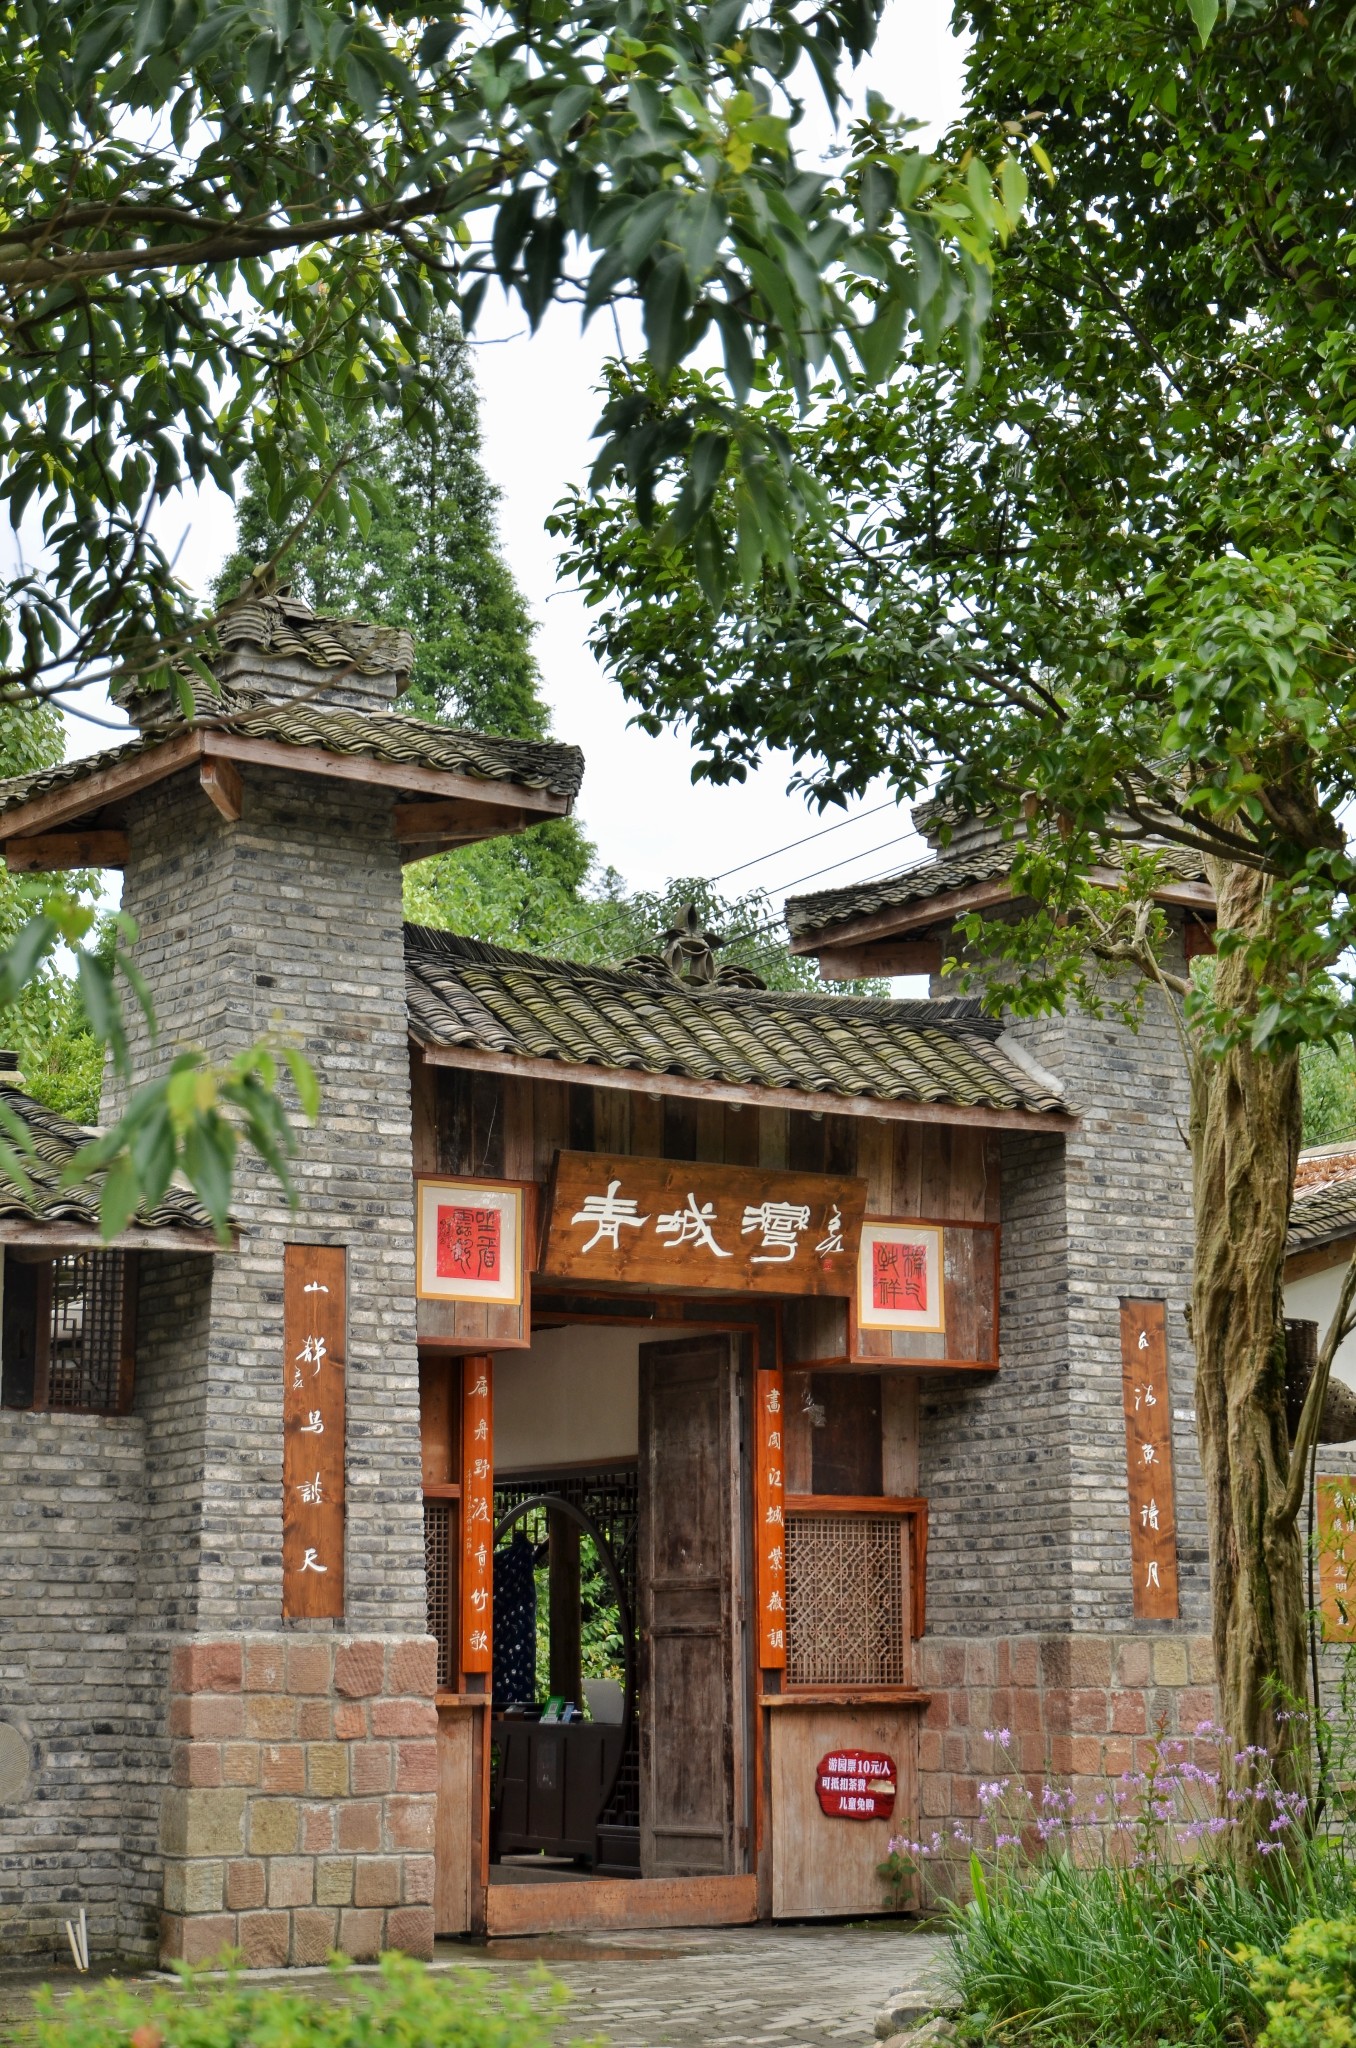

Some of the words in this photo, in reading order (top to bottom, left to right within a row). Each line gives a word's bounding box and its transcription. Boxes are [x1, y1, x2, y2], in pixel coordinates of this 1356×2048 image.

[821, 1776, 867, 1792] 可抵扣茶费
[839, 1796, 875, 1812] 儿童免购
